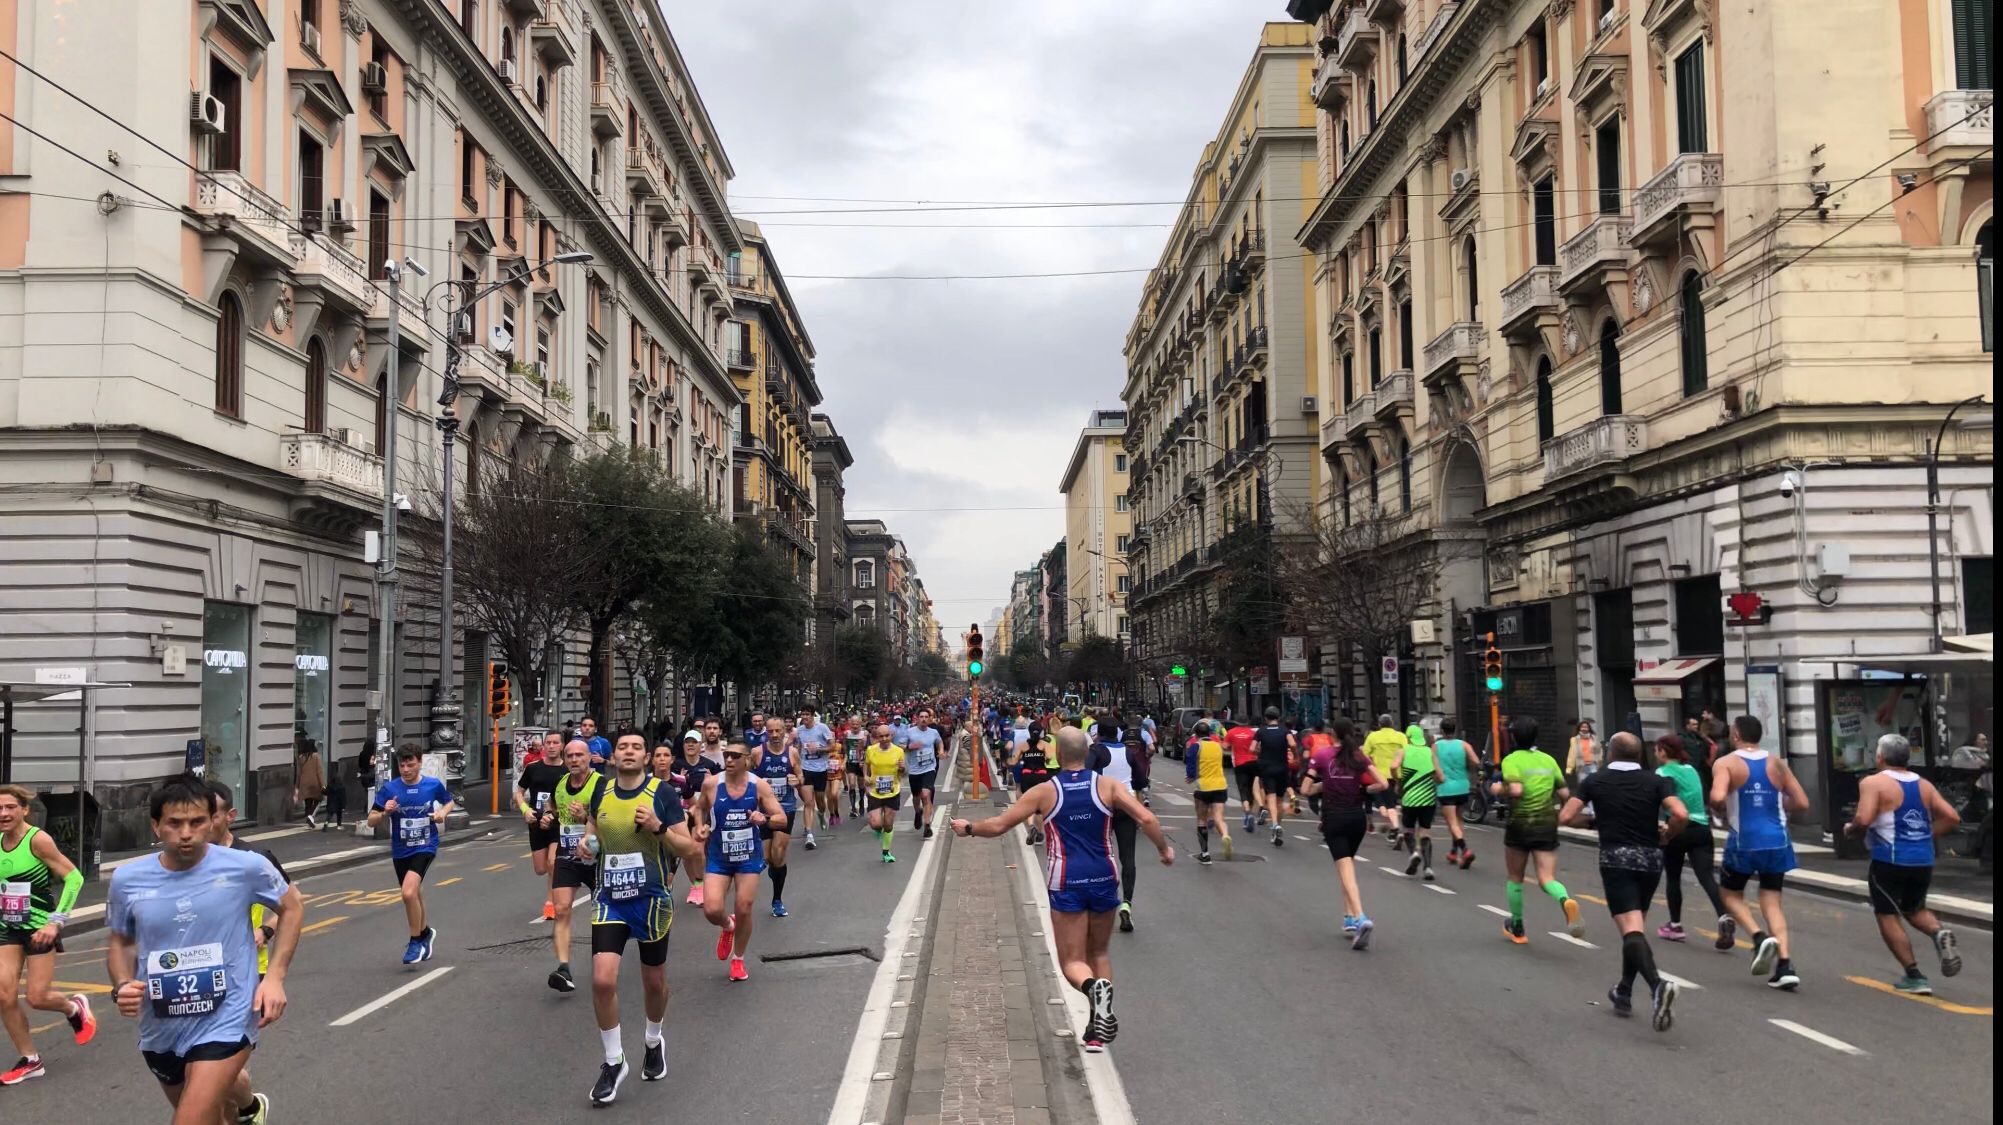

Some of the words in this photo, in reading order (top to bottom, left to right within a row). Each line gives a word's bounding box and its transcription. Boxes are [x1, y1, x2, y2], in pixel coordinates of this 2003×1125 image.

[1069, 813, 1092, 821] VINCI
[729, 842, 747, 853] 2032
[611, 871, 636, 886] 4644
[6, 898, 19, 910] 215
[180, 948, 211, 958] NAPOLI
[177, 974, 199, 995] 32
[168, 1000, 214, 1015] RUNCZECH
